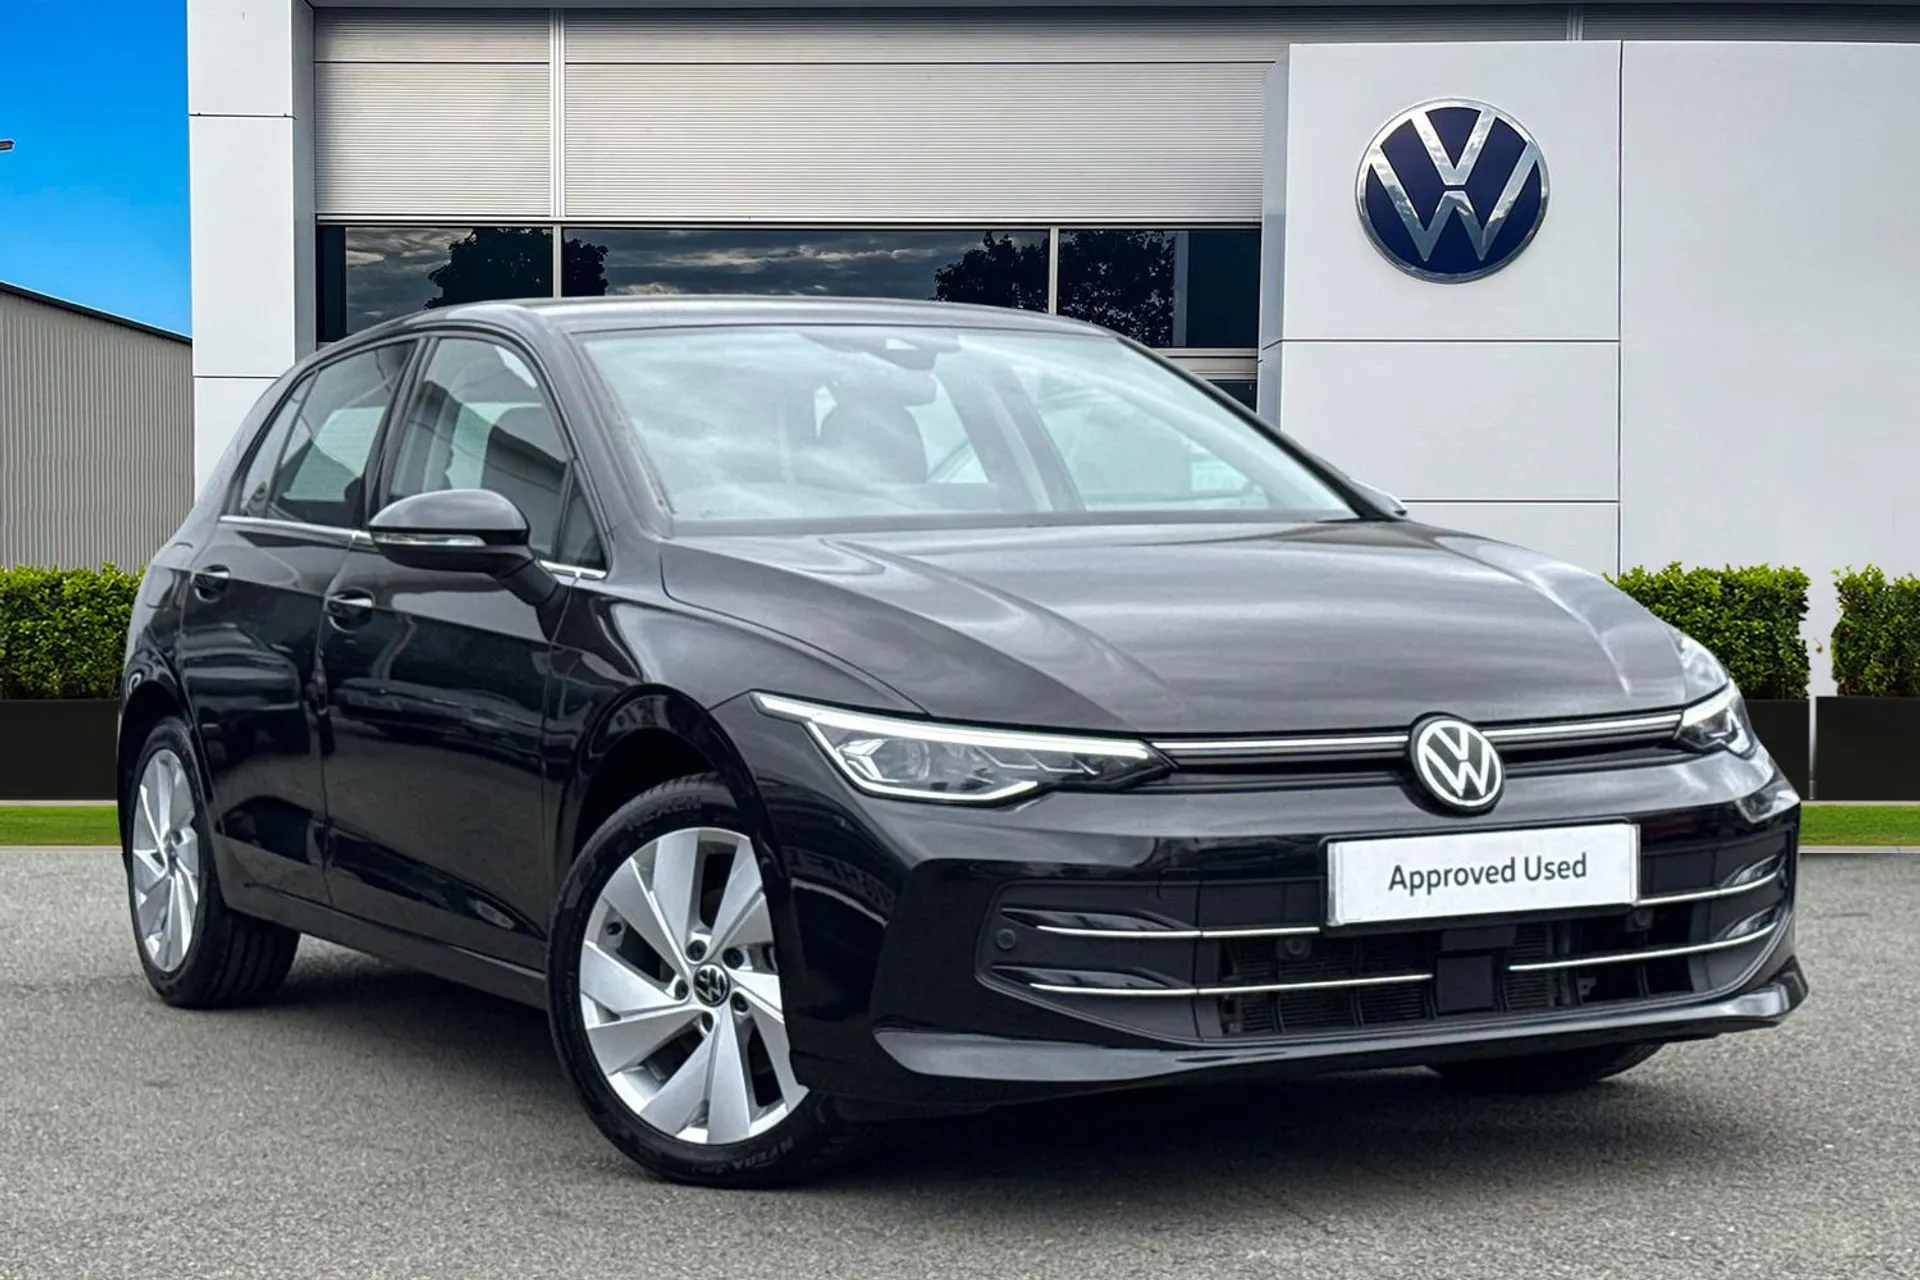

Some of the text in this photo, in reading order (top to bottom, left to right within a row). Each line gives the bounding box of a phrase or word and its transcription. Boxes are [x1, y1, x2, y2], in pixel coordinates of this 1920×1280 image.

[1362, 102, 1544, 268] VW
[1419, 722, 1498, 801] VW
[1388, 852, 1587, 896] Approved Used
